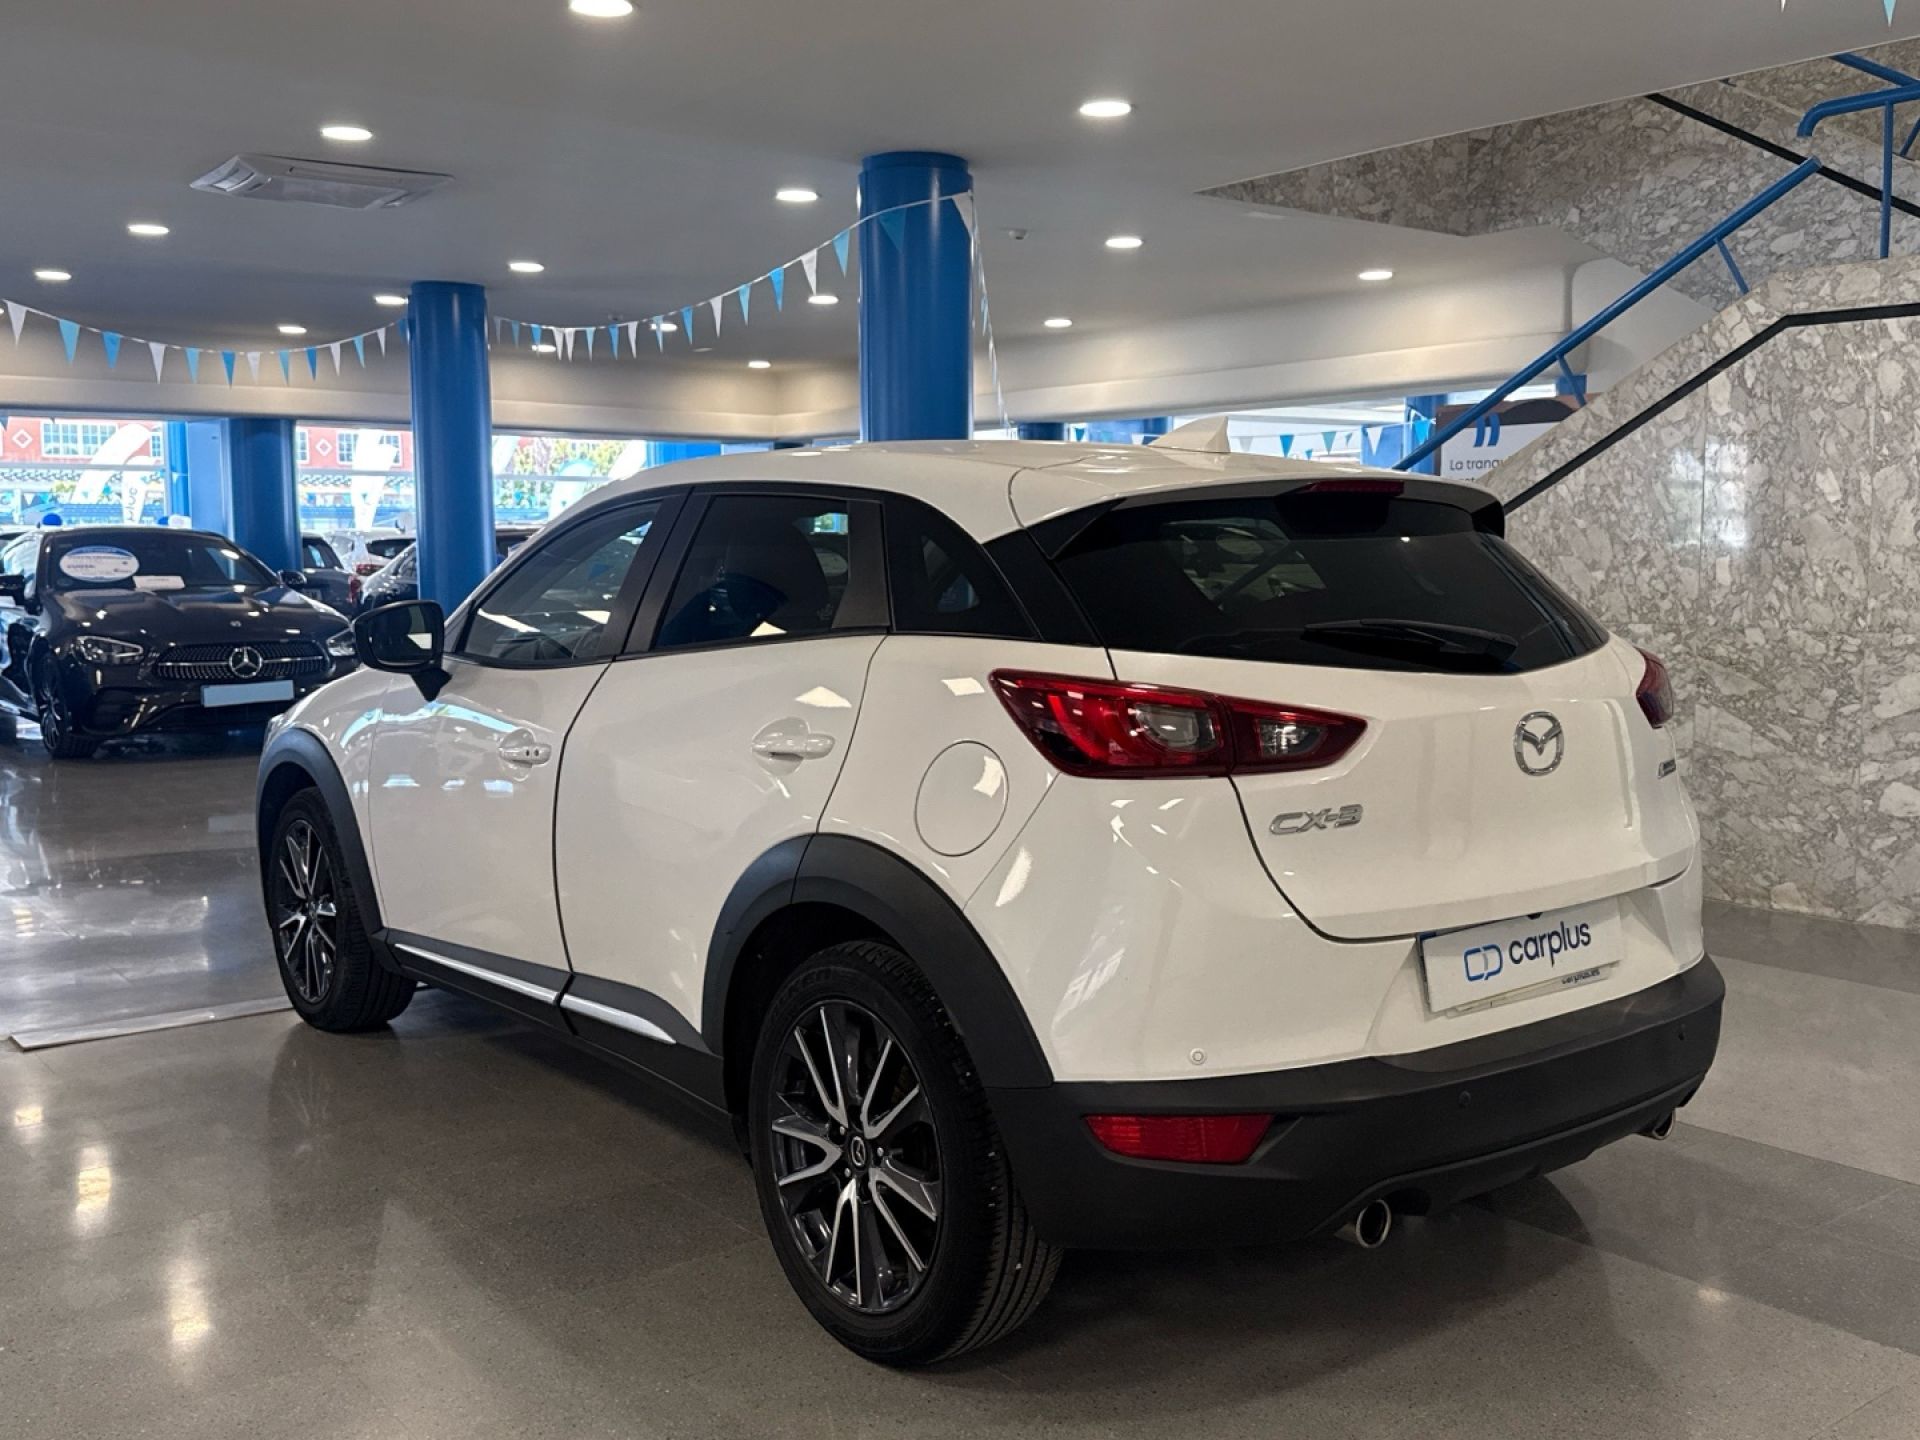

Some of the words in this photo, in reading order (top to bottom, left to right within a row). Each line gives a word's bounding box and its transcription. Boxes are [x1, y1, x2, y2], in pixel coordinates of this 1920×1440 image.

[1450, 460, 1464, 471] La
[1269, 804, 1363, 835] CX-3
[1508, 920, 1592, 968] carplus
